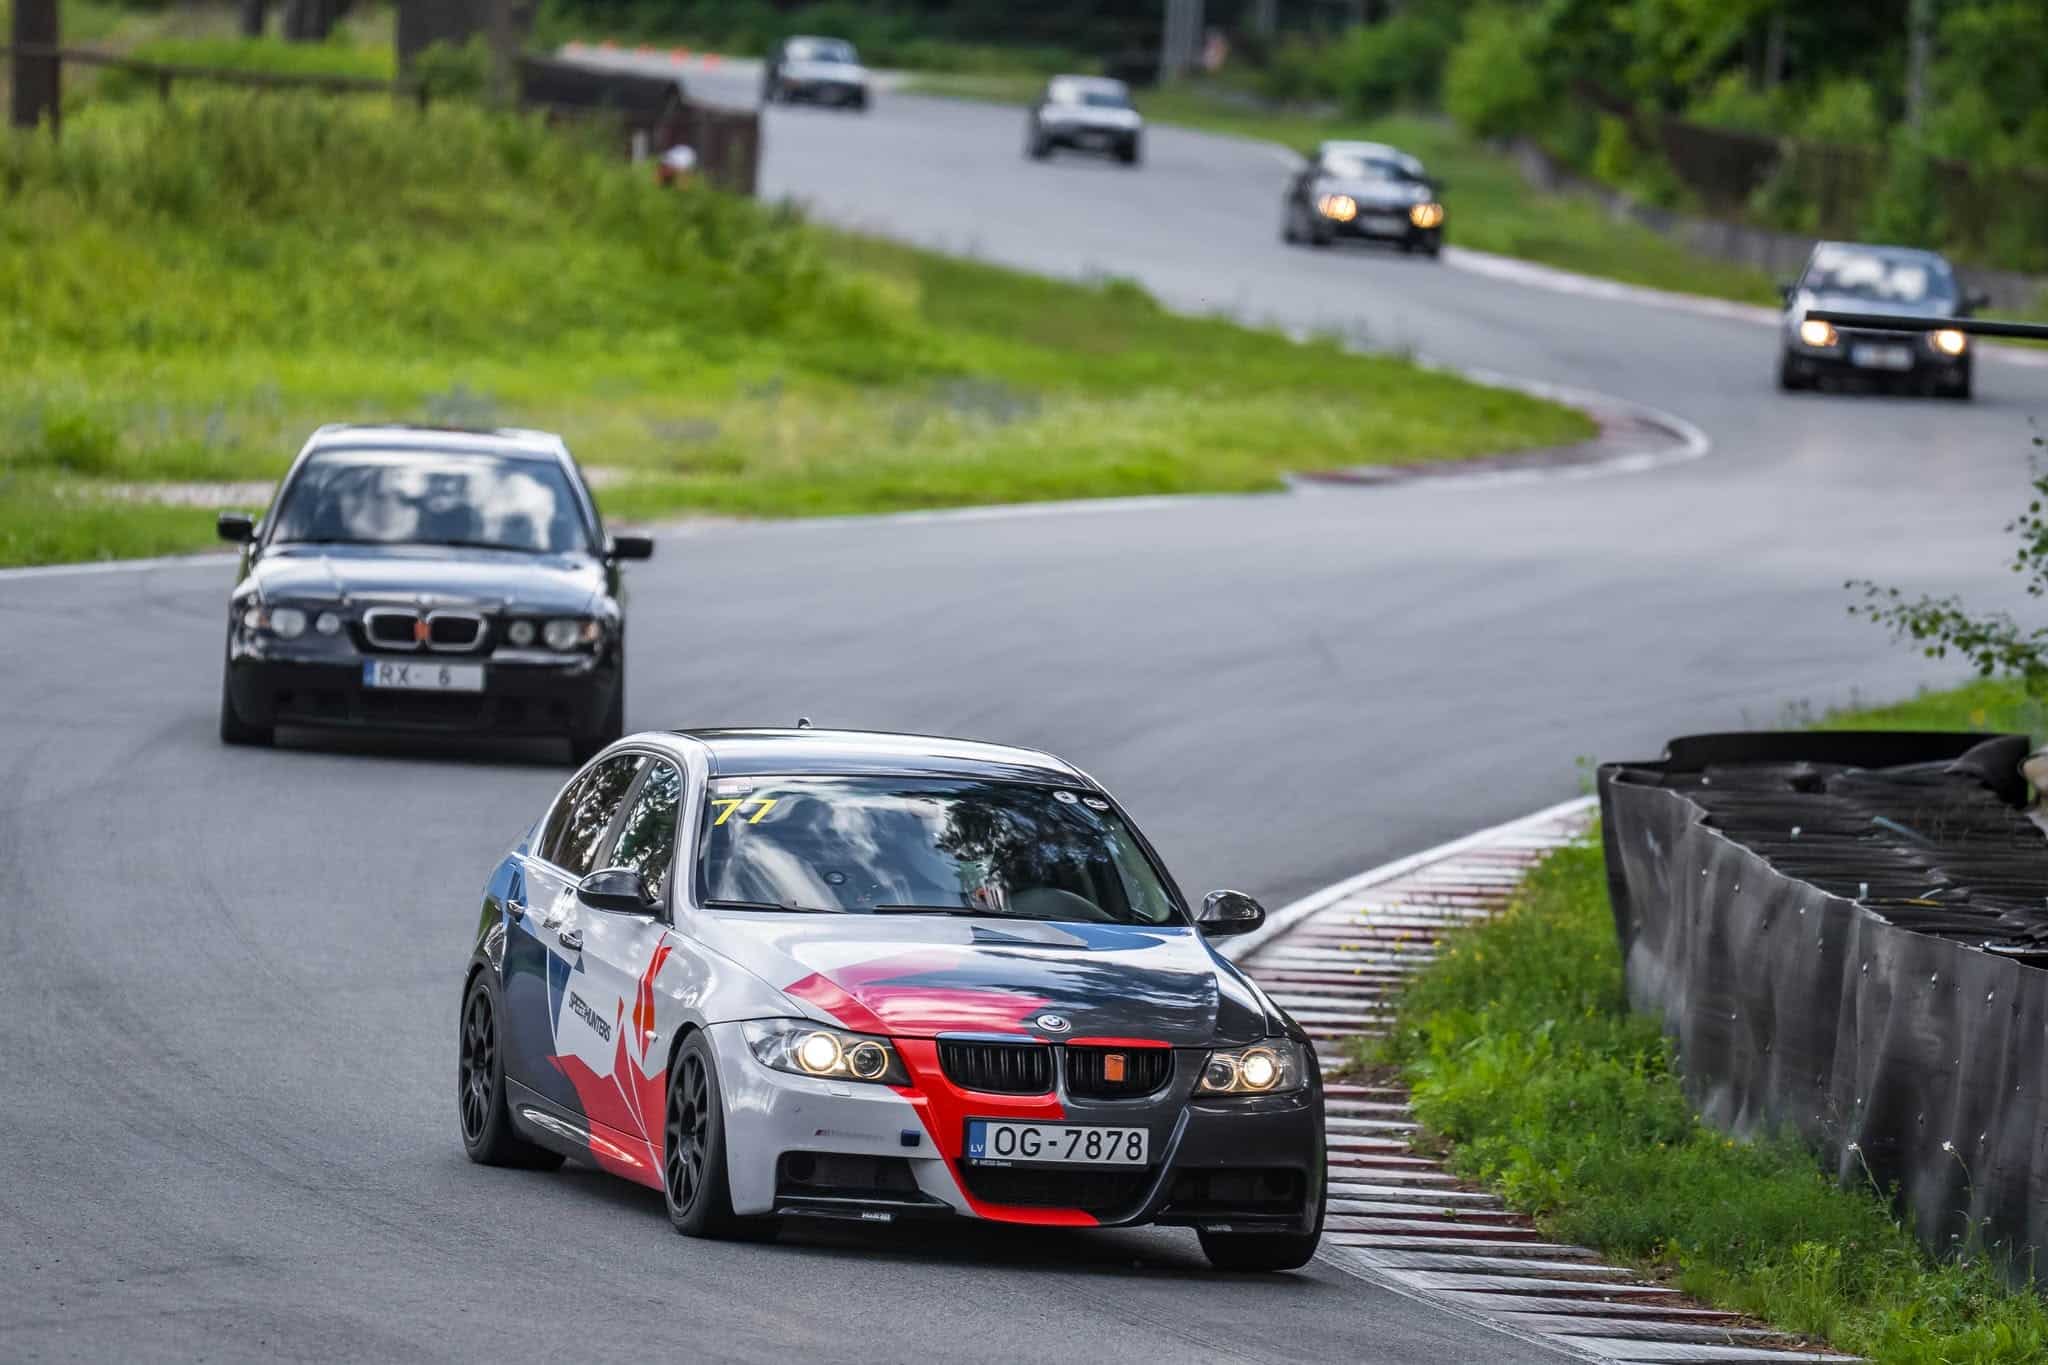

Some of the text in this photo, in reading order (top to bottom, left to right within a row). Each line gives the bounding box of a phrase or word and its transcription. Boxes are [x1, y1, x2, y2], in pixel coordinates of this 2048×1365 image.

[711, 798, 778, 825] 77
[970, 1144, 984, 1153] LV
[994, 1126, 1143, 1161] OG-7878
